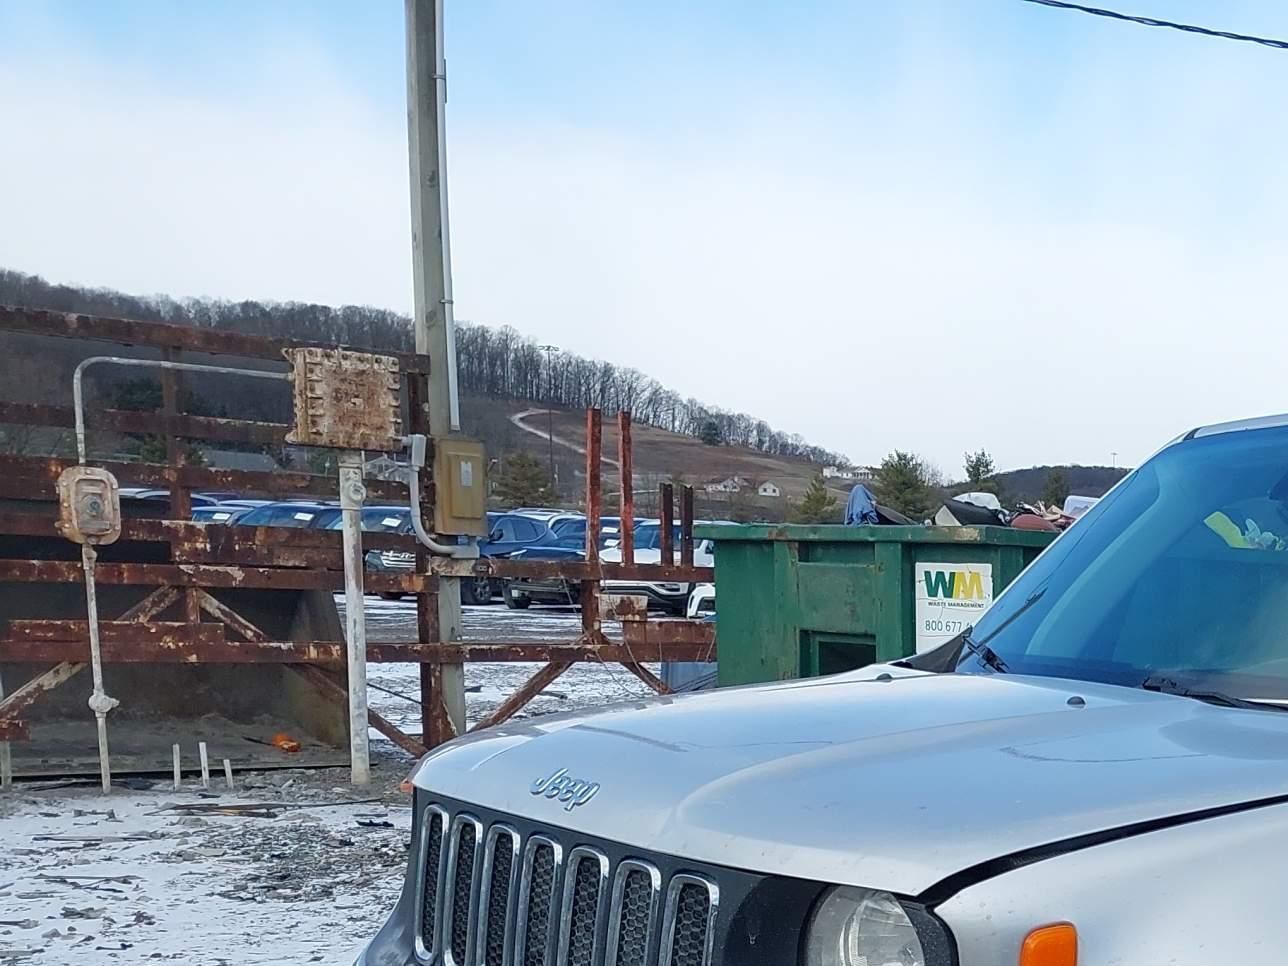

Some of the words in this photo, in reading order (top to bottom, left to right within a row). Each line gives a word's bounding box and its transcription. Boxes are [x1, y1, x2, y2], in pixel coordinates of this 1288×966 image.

[924, 570, 984, 600] WM
[925, 620, 943, 632] 800
[945, 621, 962, 633] 677
[530, 767, 600, 812] Jeep
